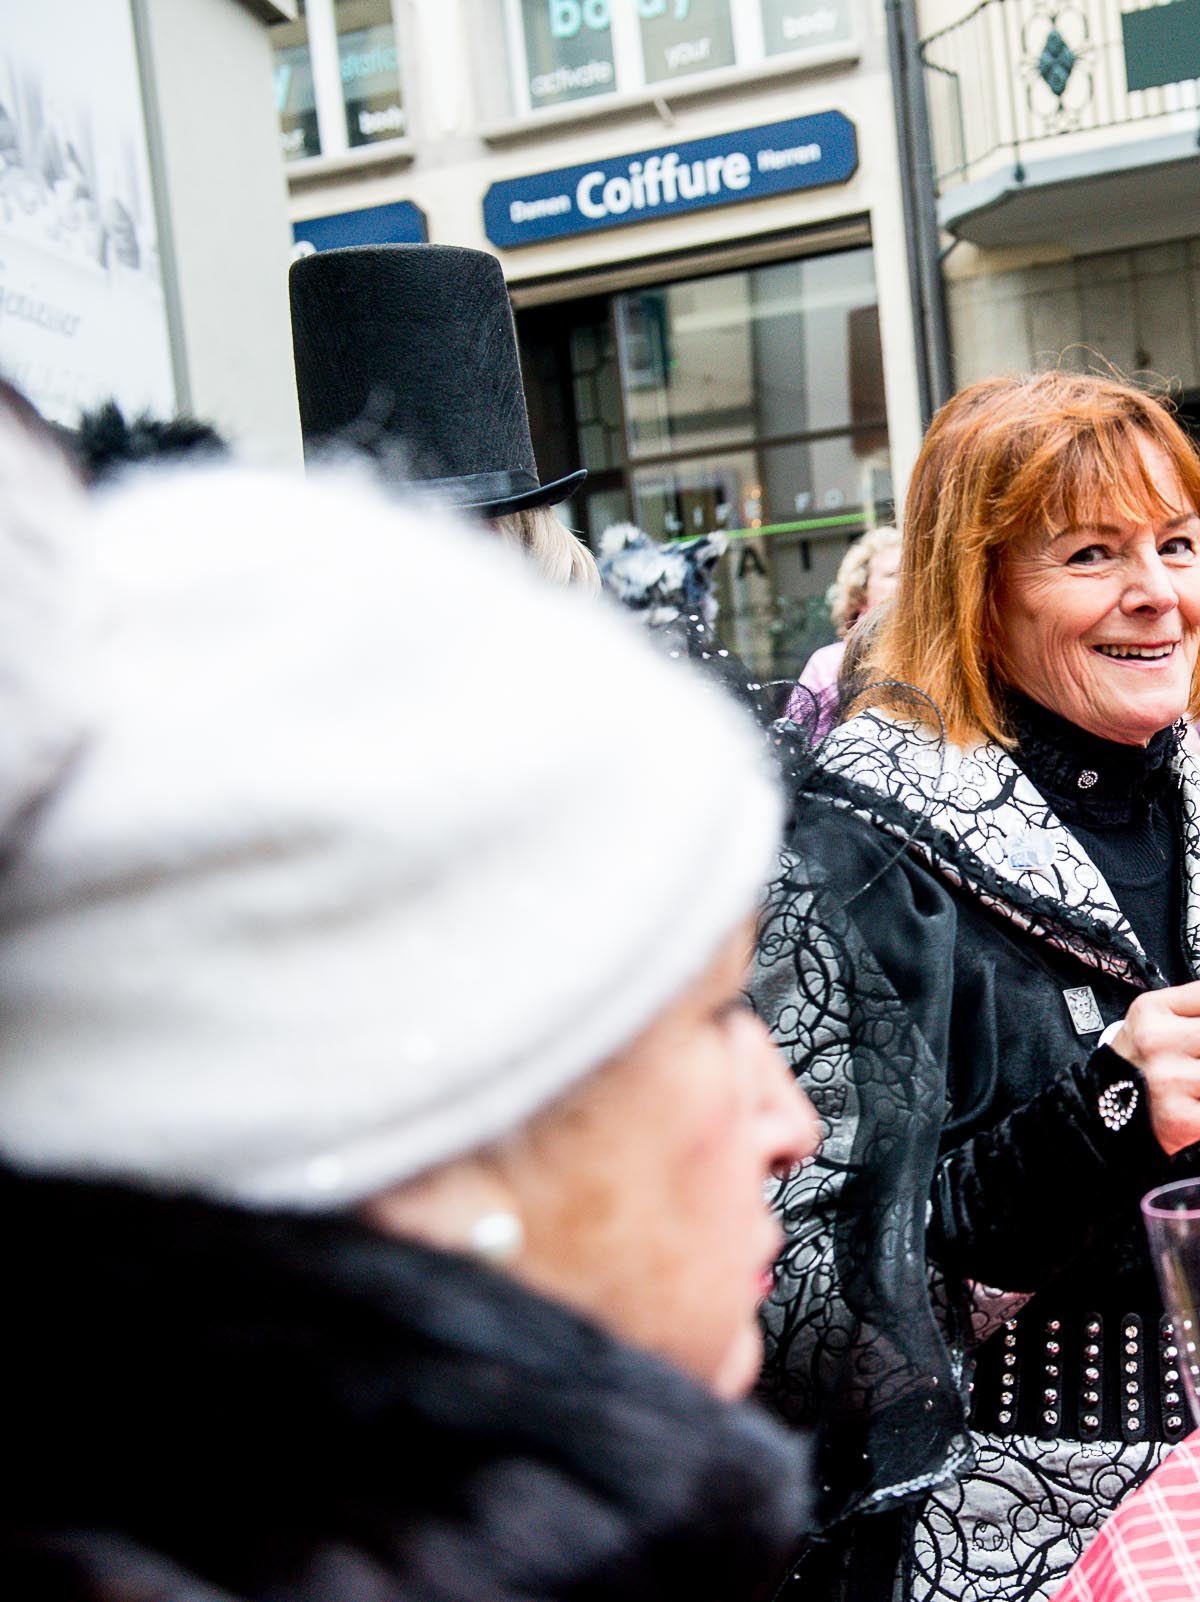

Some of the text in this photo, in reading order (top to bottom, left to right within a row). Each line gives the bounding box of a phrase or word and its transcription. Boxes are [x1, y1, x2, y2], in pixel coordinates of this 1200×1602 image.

[664, 38, 712, 72] your
[509, 194, 572, 224] Damen
[576, 152, 751, 219] Coiffure
